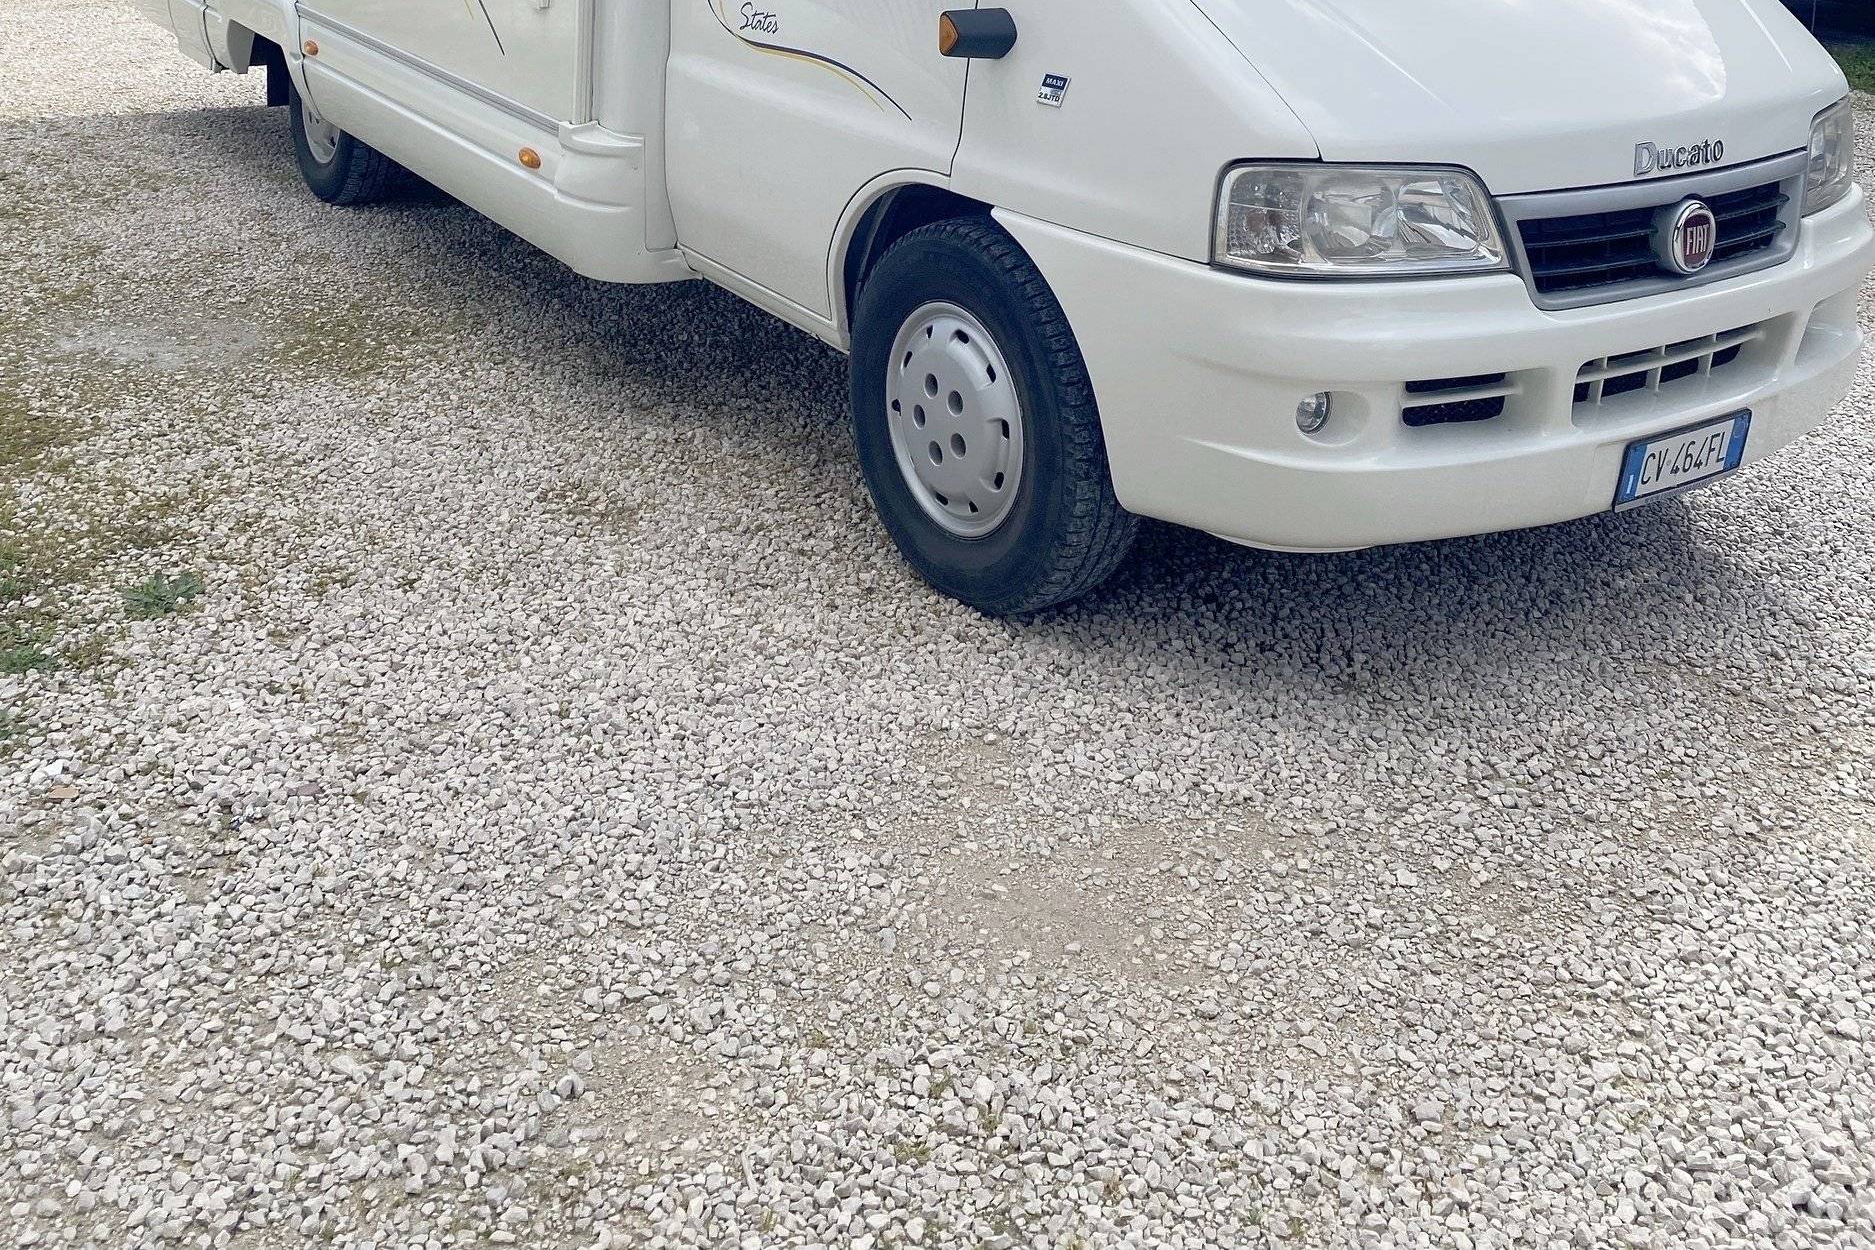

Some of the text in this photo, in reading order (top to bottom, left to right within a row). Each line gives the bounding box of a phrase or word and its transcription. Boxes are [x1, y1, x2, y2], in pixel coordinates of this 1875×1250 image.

[739, 1, 780, 35] States
[1633, 138, 1724, 177] Ducato
[1686, 223, 1710, 256] FIAT
